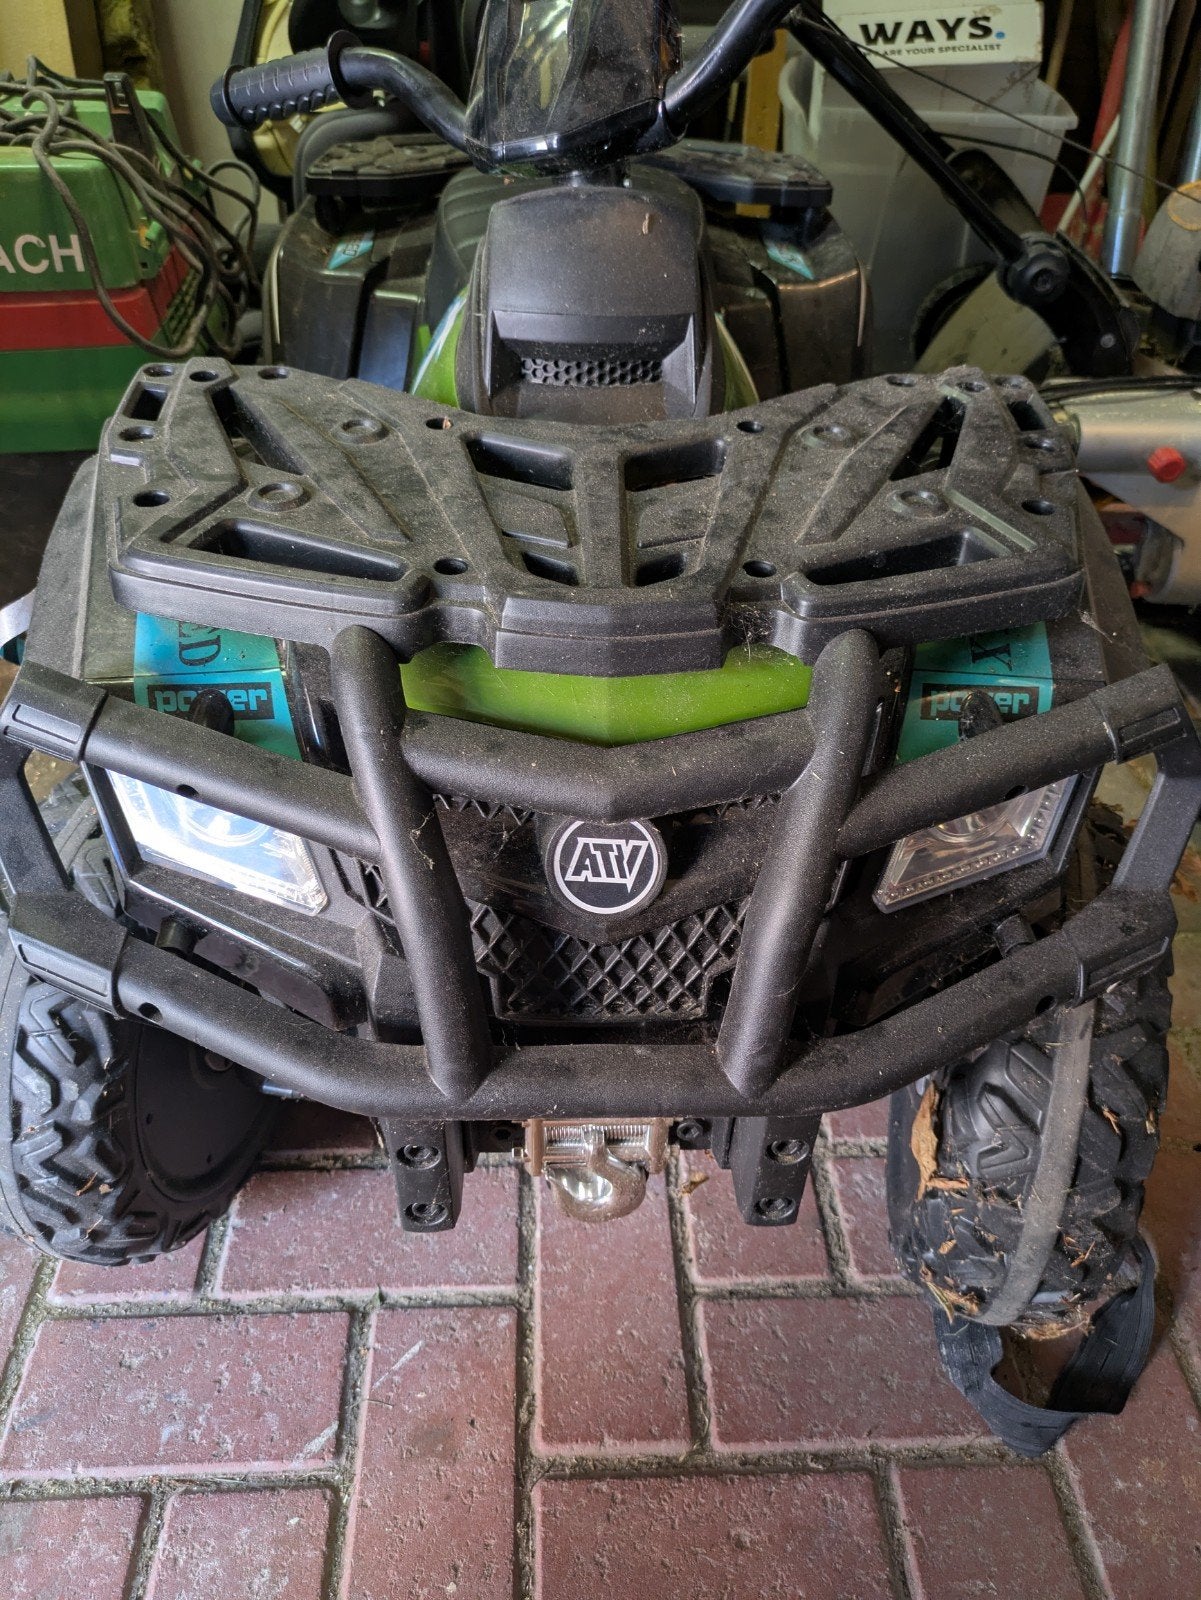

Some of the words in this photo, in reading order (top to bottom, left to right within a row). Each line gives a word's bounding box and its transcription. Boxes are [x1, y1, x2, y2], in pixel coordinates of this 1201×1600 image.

[906, 47, 934, 55] YOUR
[938, 43, 1002, 53] SPECIALIST
[564, 837, 649, 893] ATV
